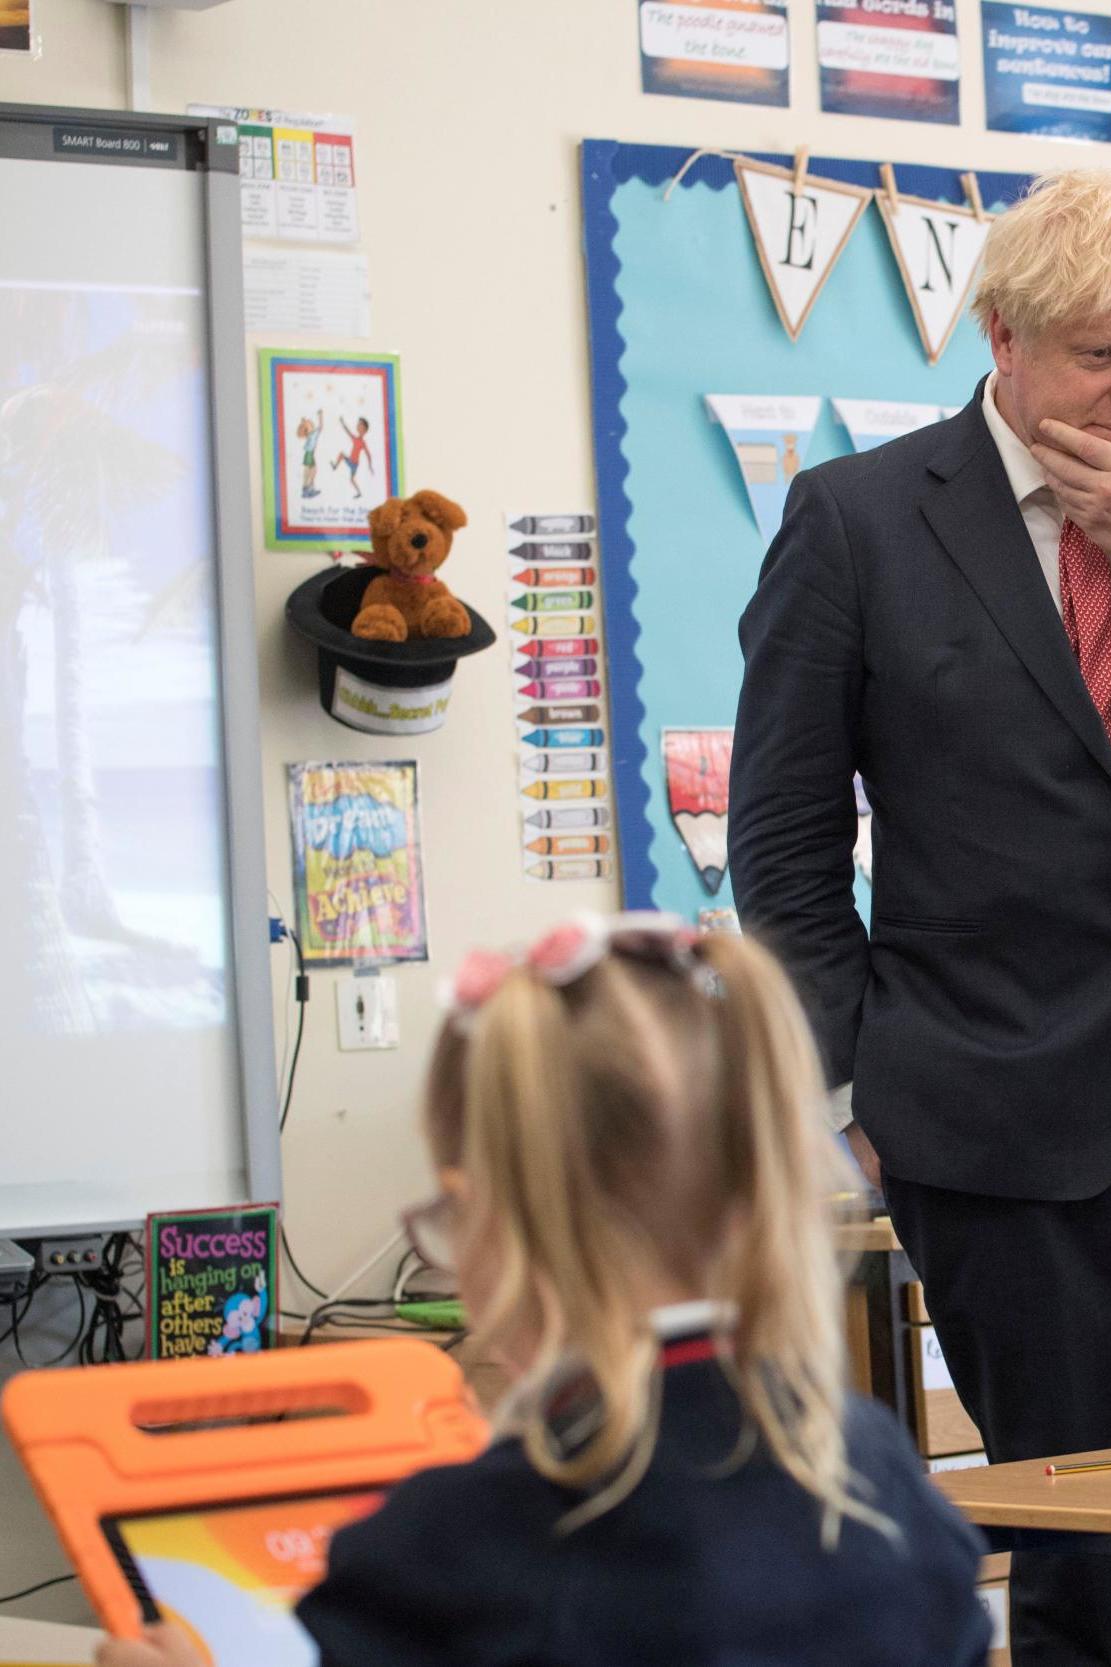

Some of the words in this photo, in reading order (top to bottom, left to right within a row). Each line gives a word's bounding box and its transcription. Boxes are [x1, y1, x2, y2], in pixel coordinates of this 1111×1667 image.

[1013, 8, 1060, 30] How
[1064, 15, 1090, 35] to
[987, 28, 1078, 56] improve
[61, 134, 94, 147] SMART
[96, 137, 121, 149] Board
[123, 139, 141, 152] 800
[314, 880, 408, 923] Achieve
[160, 1226, 267, 1259] Success
[160, 1266, 236, 1297] hanging
[240, 1262, 262, 1280] on
[168, 1258, 186, 1277] is
[161, 1290, 215, 1317] after
[160, 1313, 223, 1336] others
[160, 1332, 206, 1358] have
